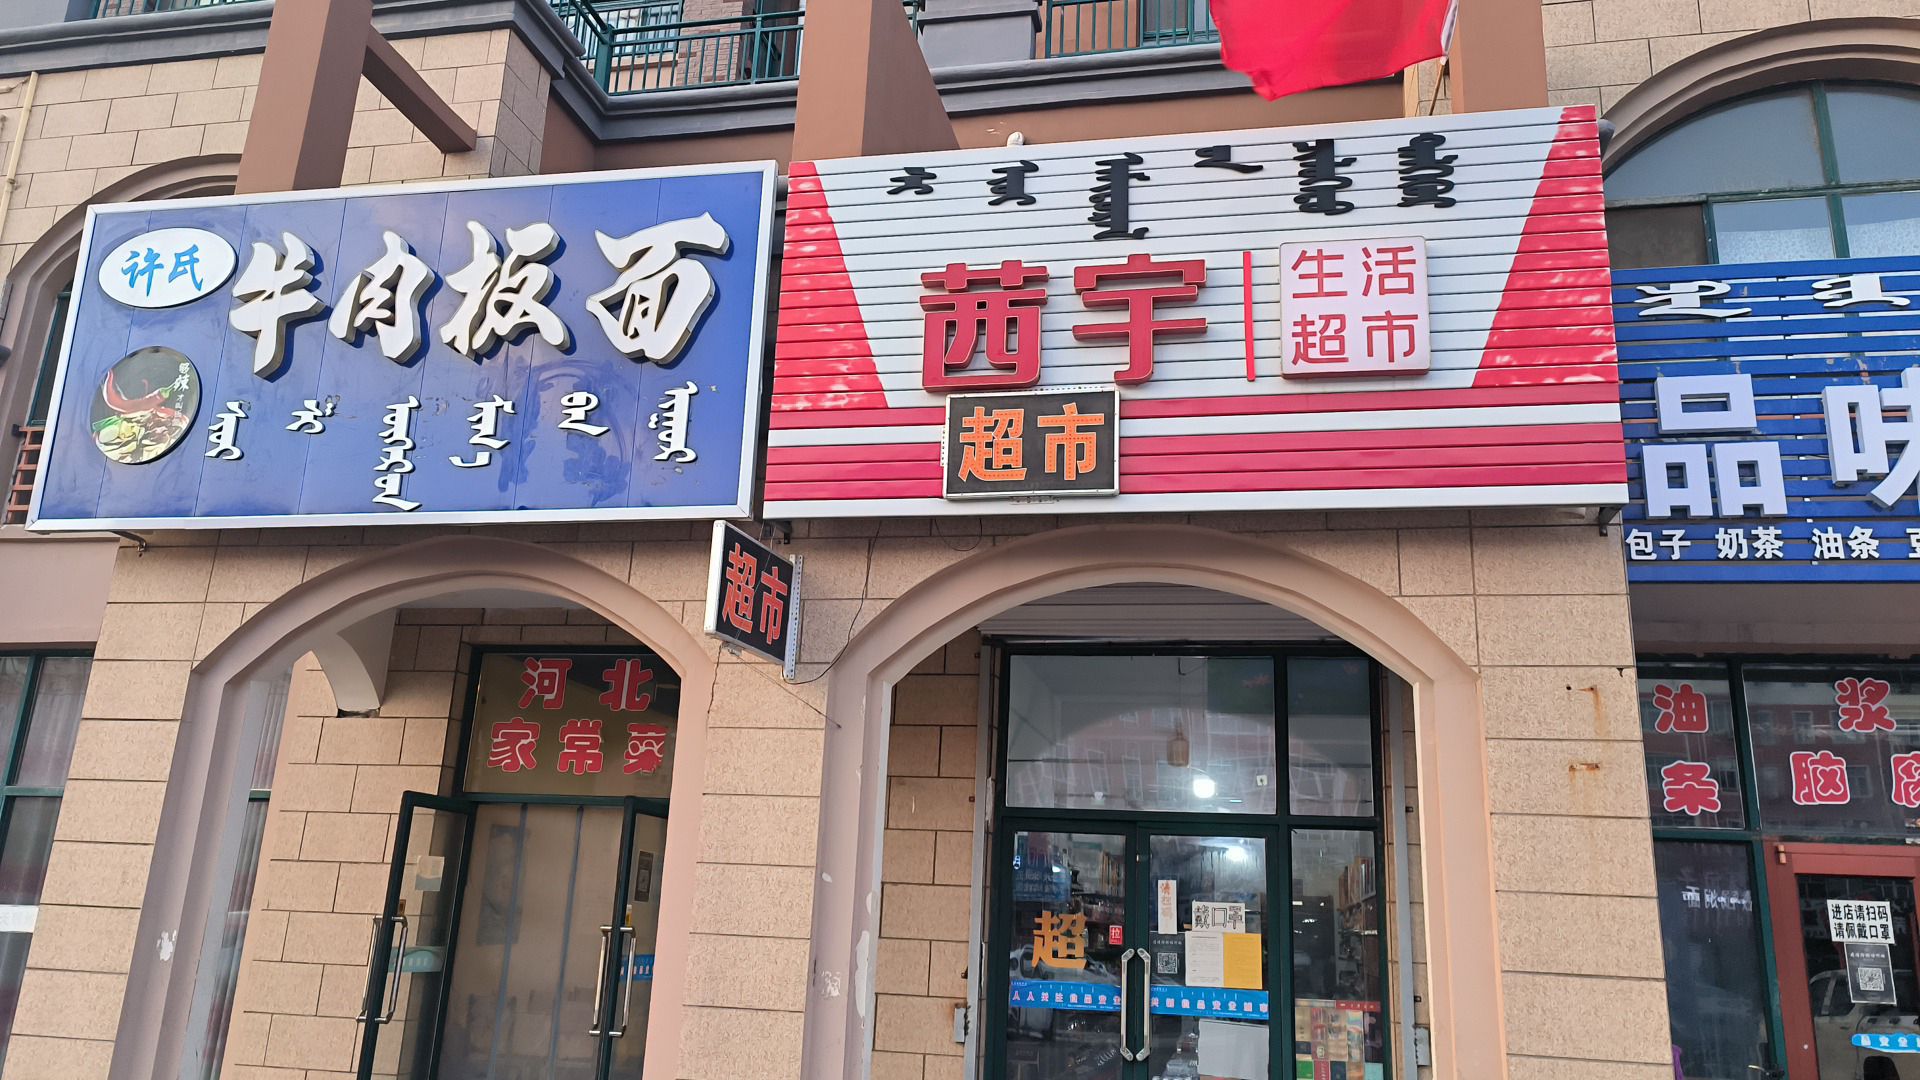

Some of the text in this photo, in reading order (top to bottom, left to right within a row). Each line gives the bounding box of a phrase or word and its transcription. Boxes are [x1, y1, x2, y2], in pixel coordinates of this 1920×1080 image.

[120, 249, 206, 298] 许氏
[228, 211, 731, 381] 牛肉板面
[1290, 244, 1418, 301] 生活
[918, 252, 1208, 392] 茜宇
[1290, 308, 1418, 367] 超市
[957, 403, 1106, 483] 超市
[1626, 528, 1691, 560] 包子
[1715, 526, 1785, 560] 奶茶
[1811, 526, 1880, 560] 油条
[721, 541, 789, 646] 超市
[518, 656, 653, 711] 河北
[486, 716, 668, 776] 家常菜
[1031, 910, 1088, 970] 超
[1110, 927, 1121, 940] 拉
[1831, 903, 1889, 922] 进店请扫码
[1833, 922, 1891, 940] 请佩戴口罩
